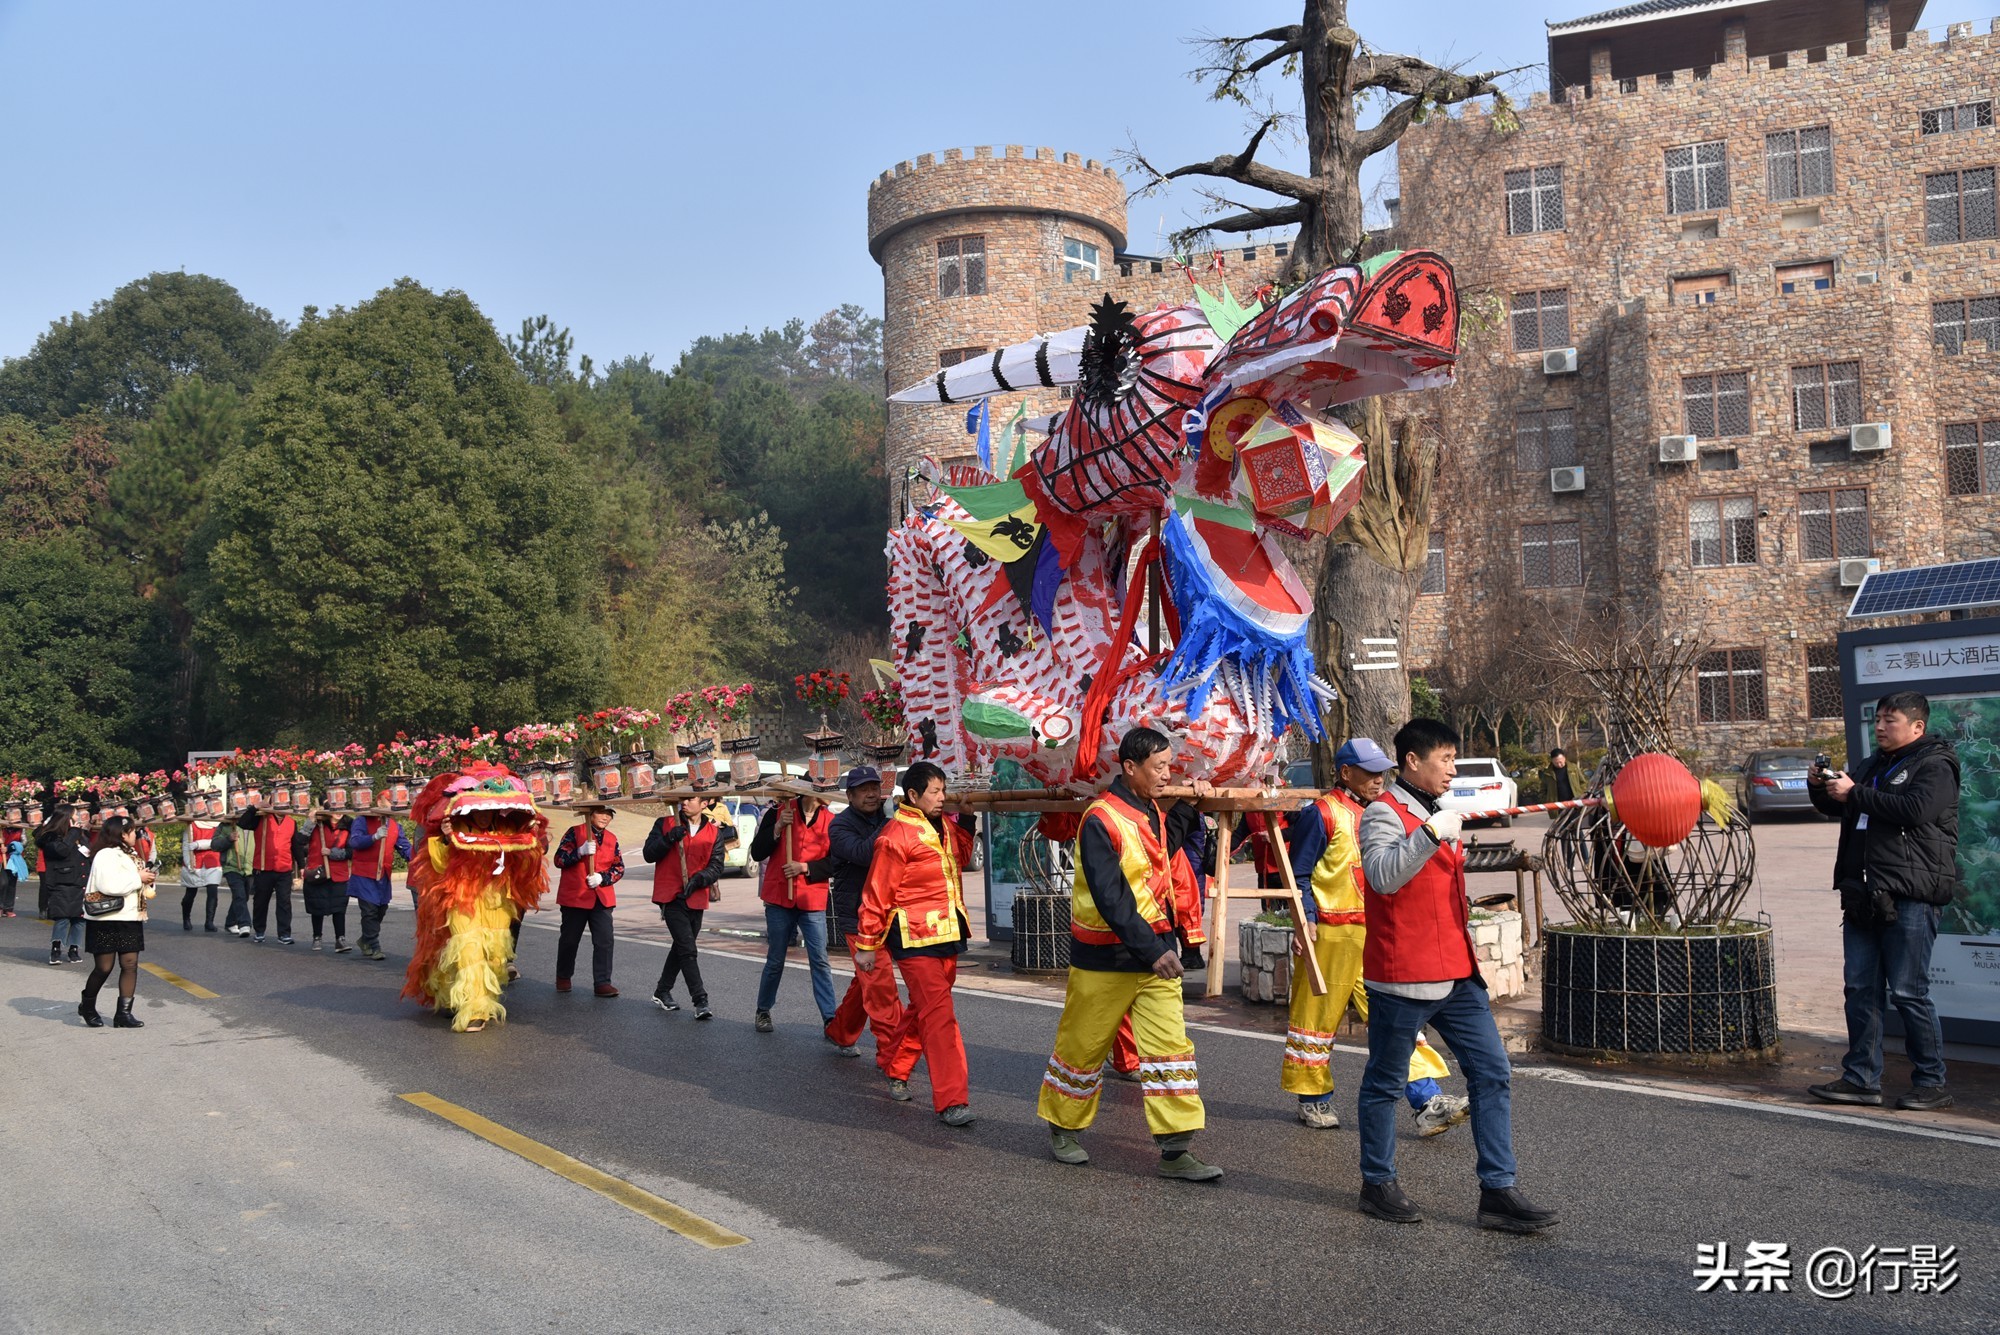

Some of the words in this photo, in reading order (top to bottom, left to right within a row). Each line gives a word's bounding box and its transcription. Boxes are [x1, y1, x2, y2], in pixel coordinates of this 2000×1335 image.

[1885, 645, 2000, 670] 云雾山大酒店
[1971, 950, 2000, 961] 木兰
